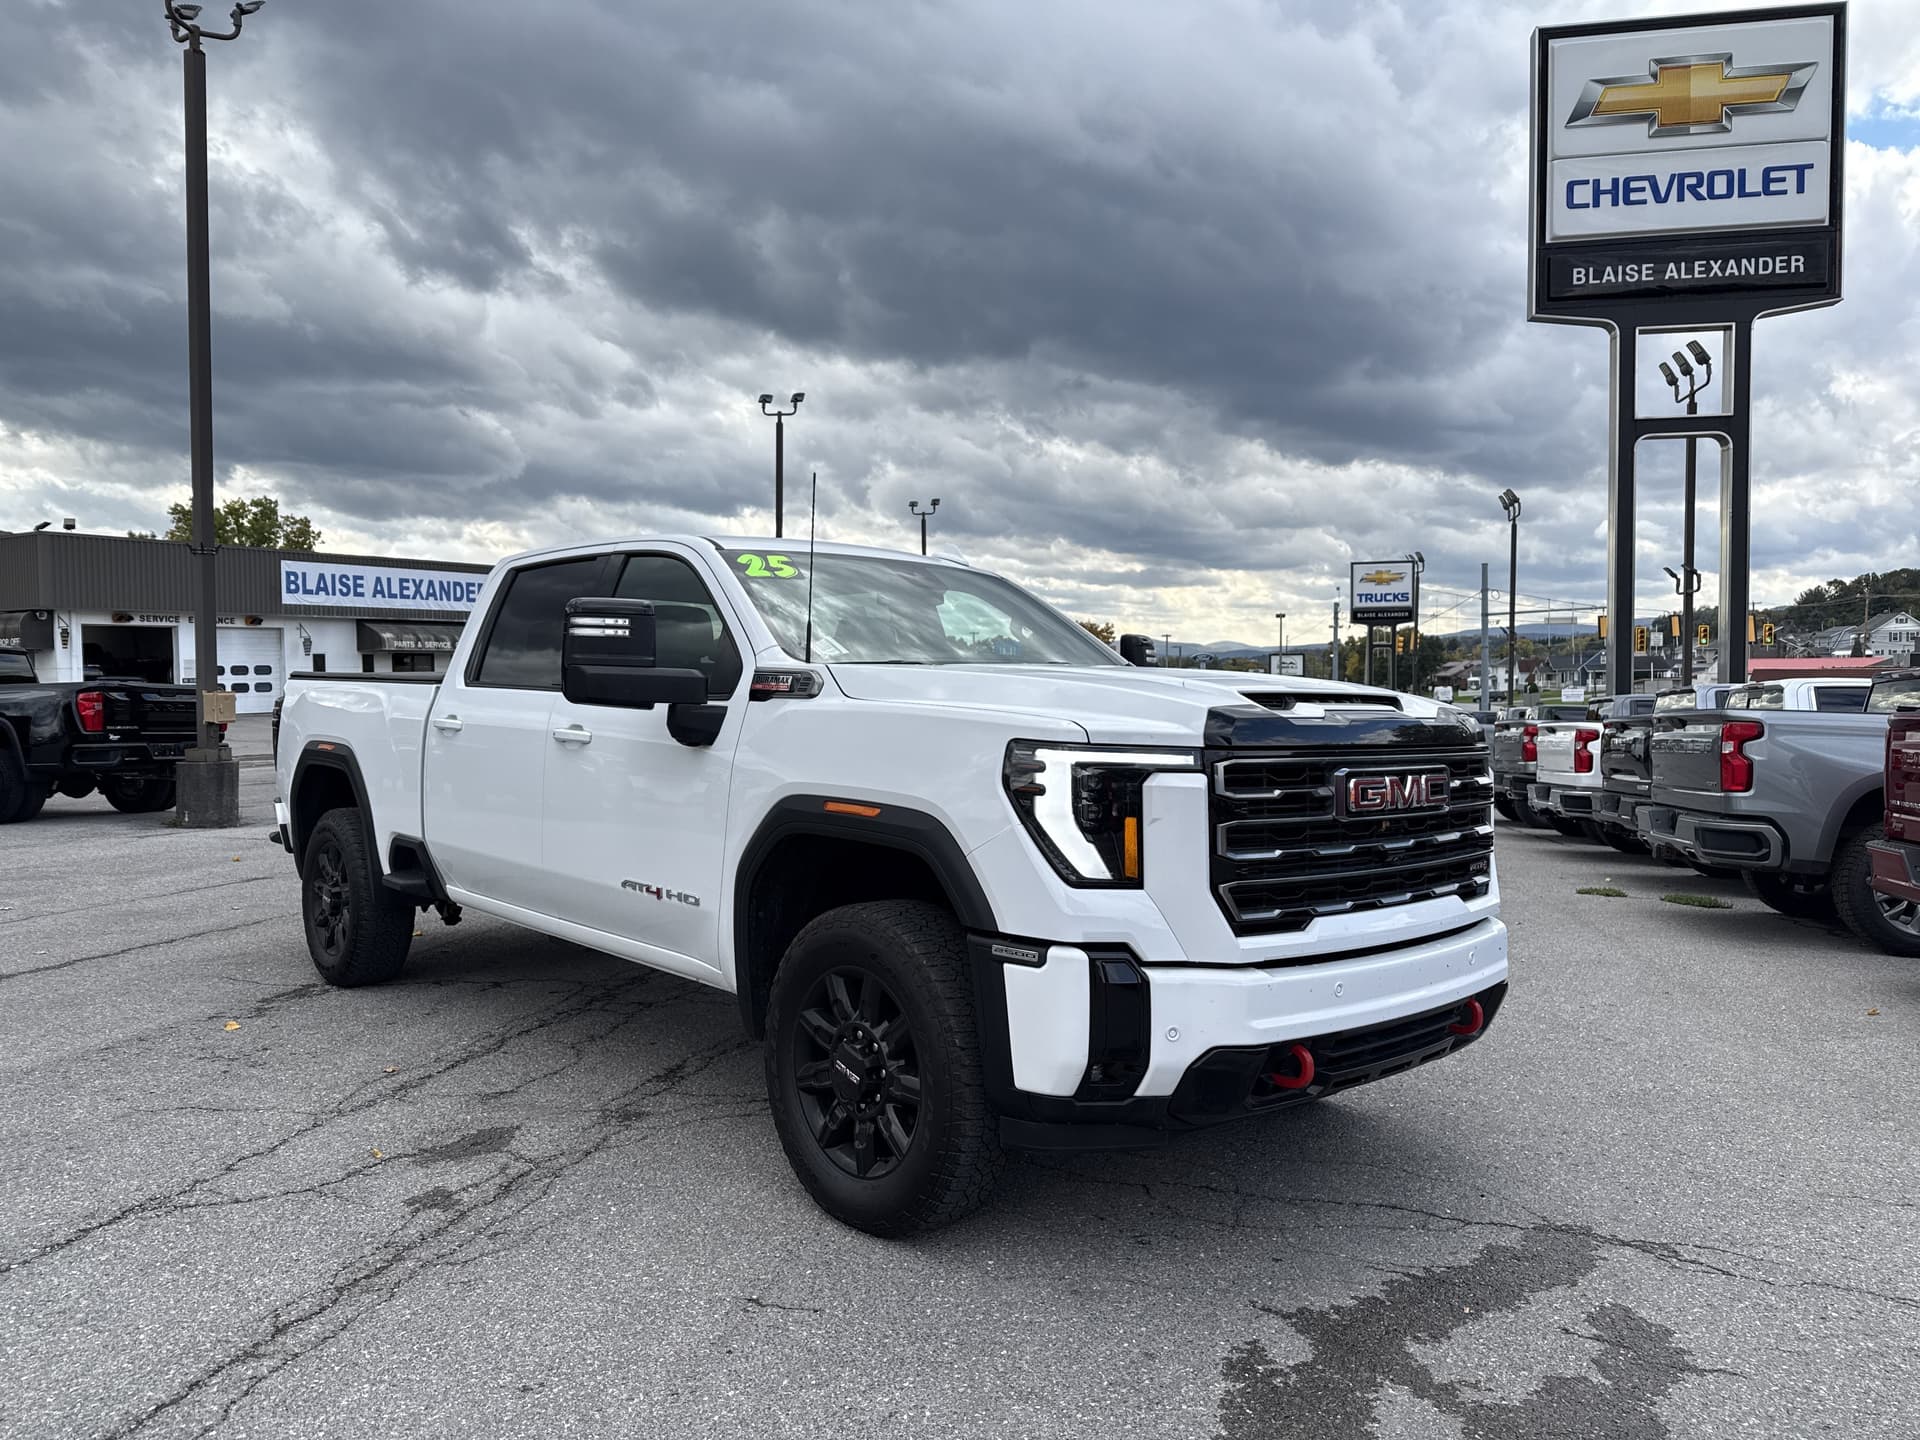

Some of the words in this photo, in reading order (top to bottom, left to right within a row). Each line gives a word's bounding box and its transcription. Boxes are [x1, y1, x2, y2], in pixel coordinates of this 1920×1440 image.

[1566, 163, 1814, 209] CHEVROLET
[1573, 264, 1654, 285] BLAISE
[1664, 255, 1805, 280] ALEXANDER
[736, 553, 799, 578] 25
[285, 571, 365, 598] BLAISE
[1357, 592, 1410, 603] TRUCKS
[139, 614, 180, 624] SERVICE
[394, 640, 415, 649] PARTS
[424, 640, 452, 649] SERVICE
[1349, 774, 1449, 812] GMC
[621, 880, 663, 900] AT4
[666, 889, 700, 907] HD
